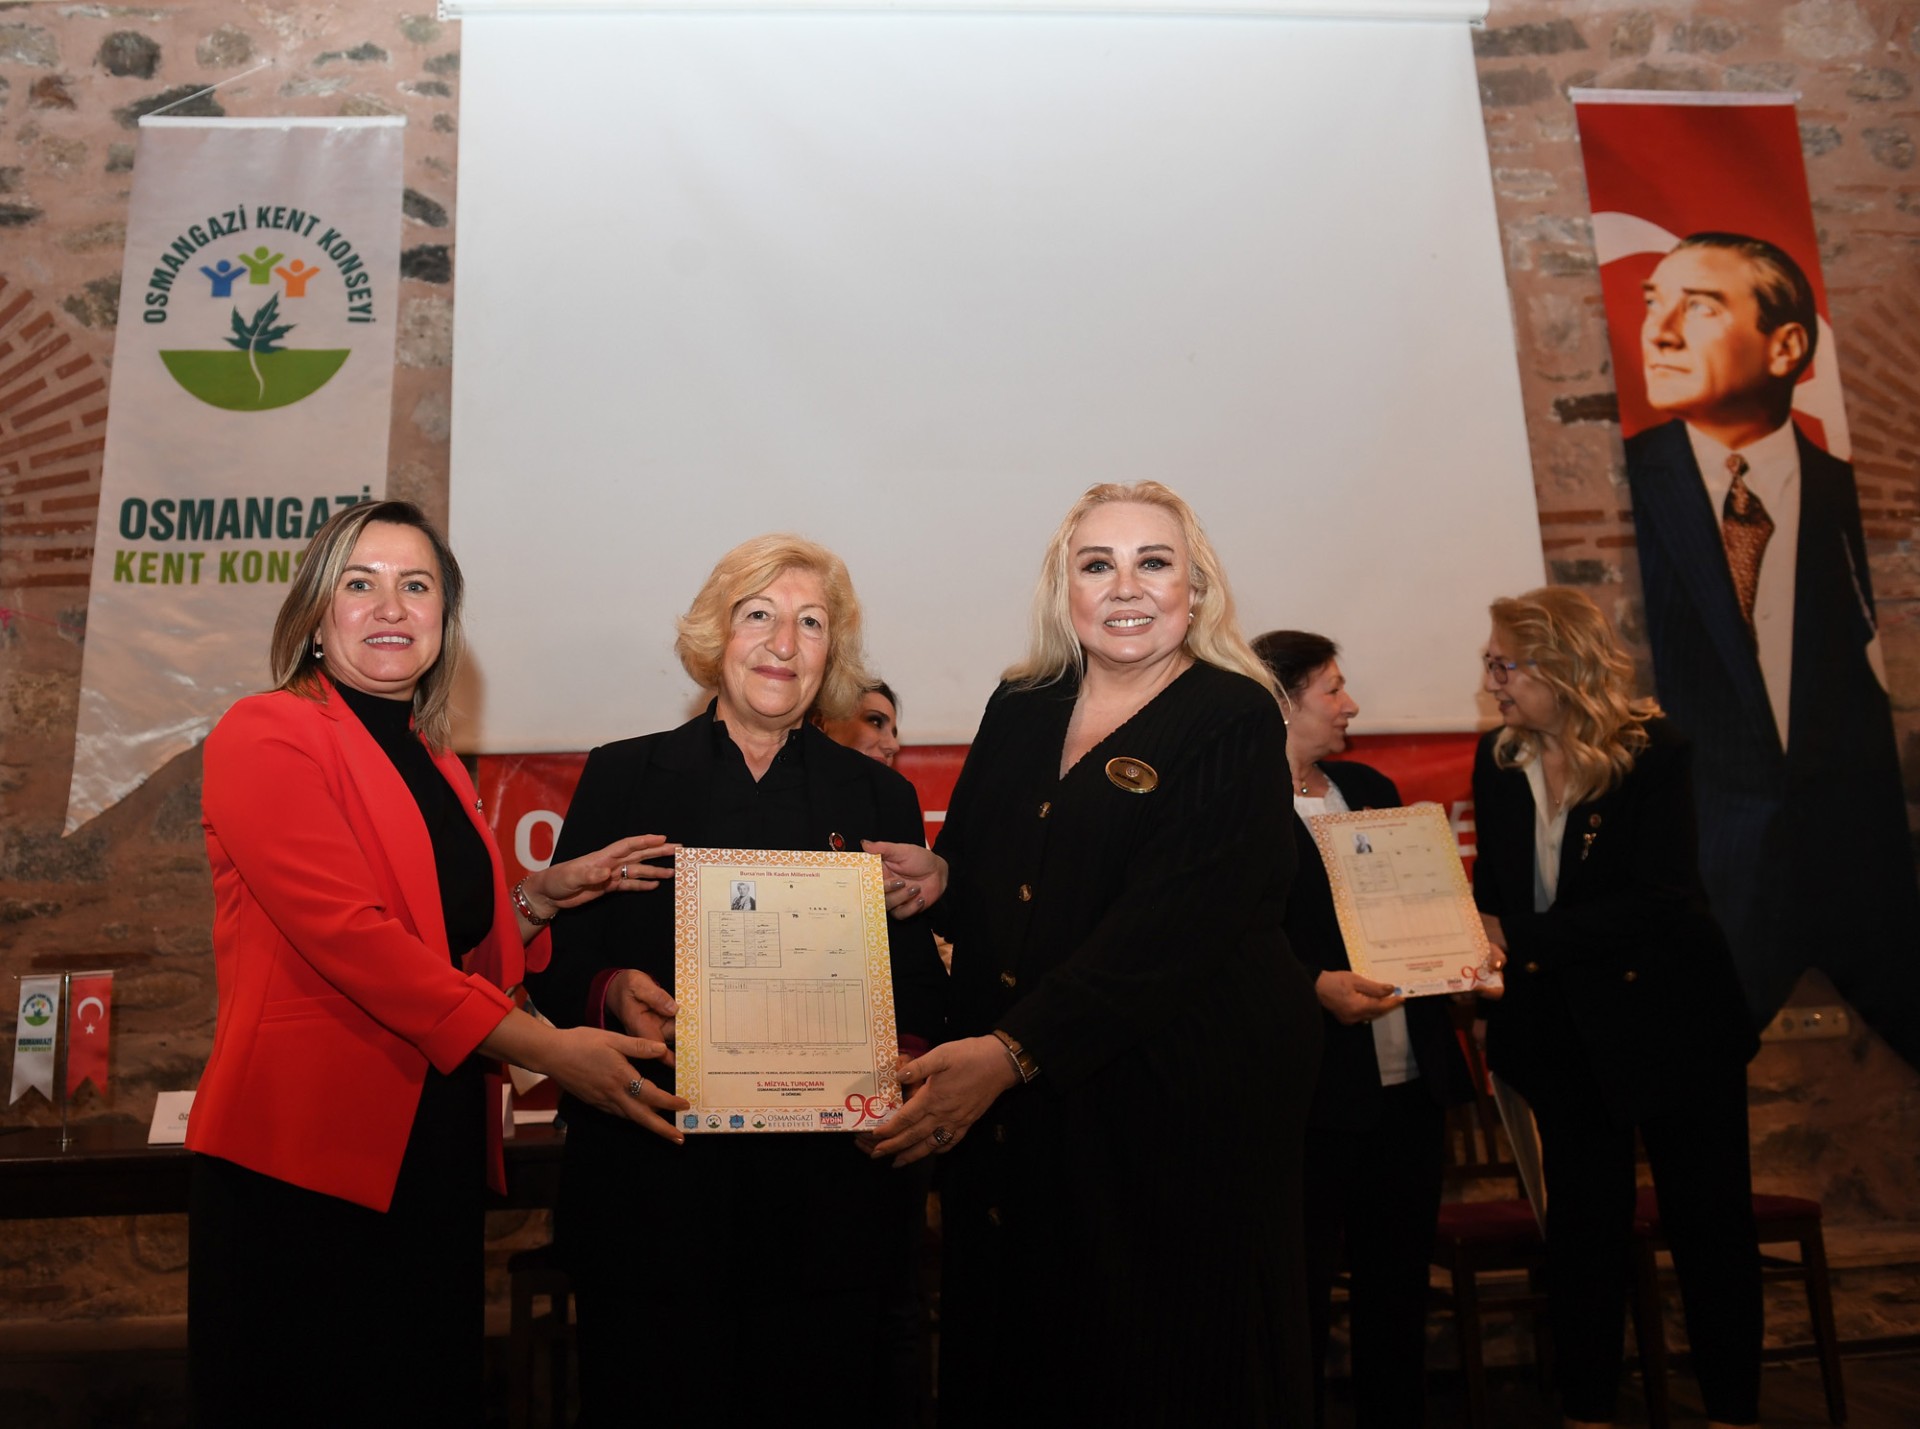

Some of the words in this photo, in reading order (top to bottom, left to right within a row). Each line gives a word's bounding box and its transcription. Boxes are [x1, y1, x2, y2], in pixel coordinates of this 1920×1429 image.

[143, 204, 248, 324] OSMANGAZİ
[256, 206, 320, 237] KENT
[316, 227, 376, 324] KONSEYİ
[119, 485, 371, 541] OSMANGA
[113, 550, 205, 584] KENT
[791, 1080, 825, 1088] TUNÇMAN
[767, 1113, 813, 1121] OSMANGAZİ
